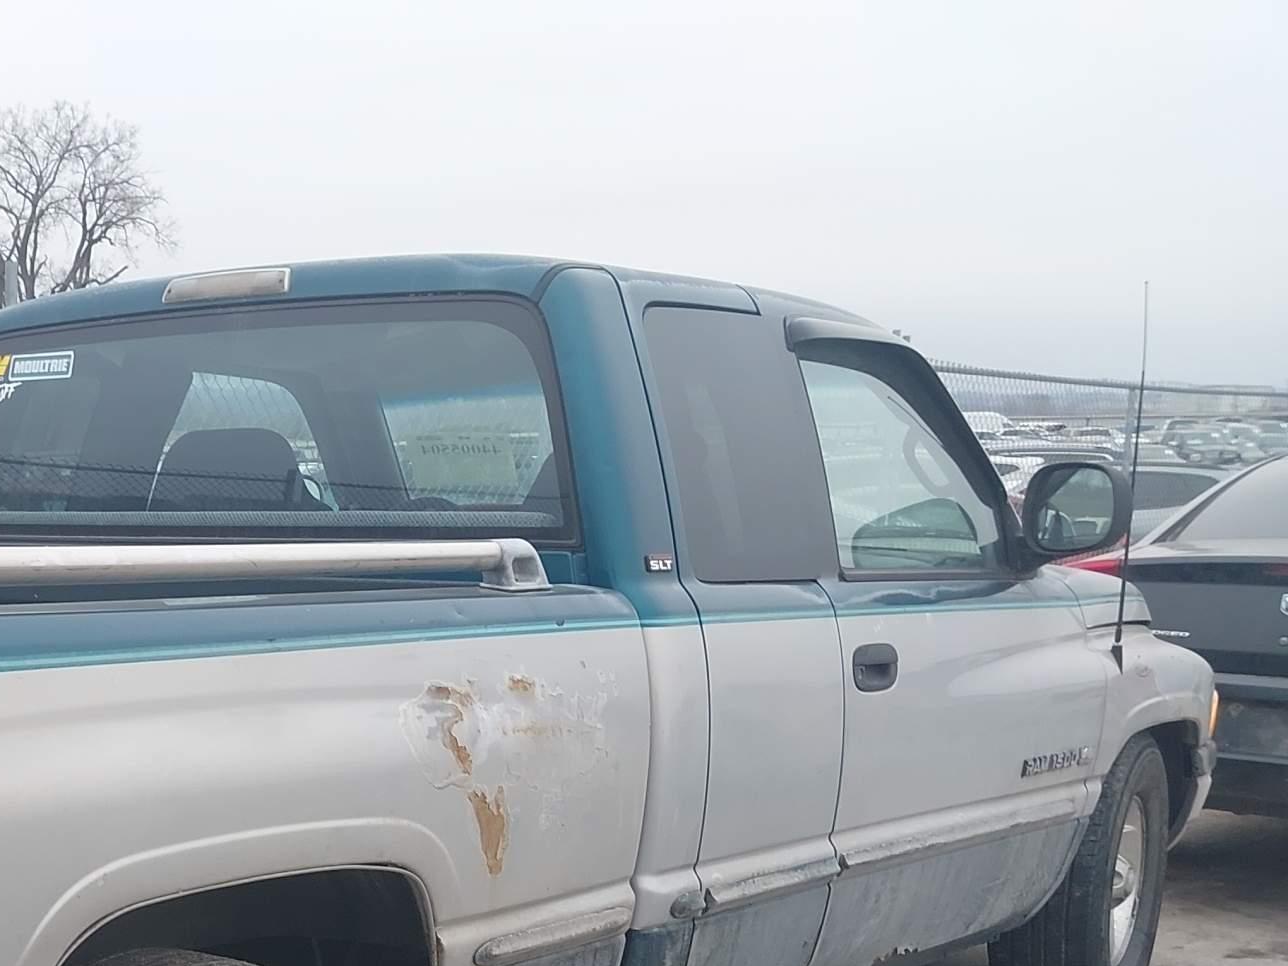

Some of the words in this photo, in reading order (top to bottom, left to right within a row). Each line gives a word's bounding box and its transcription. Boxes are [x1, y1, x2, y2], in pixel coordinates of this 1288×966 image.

[13, 358, 70, 375] MOULTRIE
[649, 559, 673, 570] SLT
[1020, 755, 1047, 778] RAM
[1049, 750, 1077, 769] 1500
